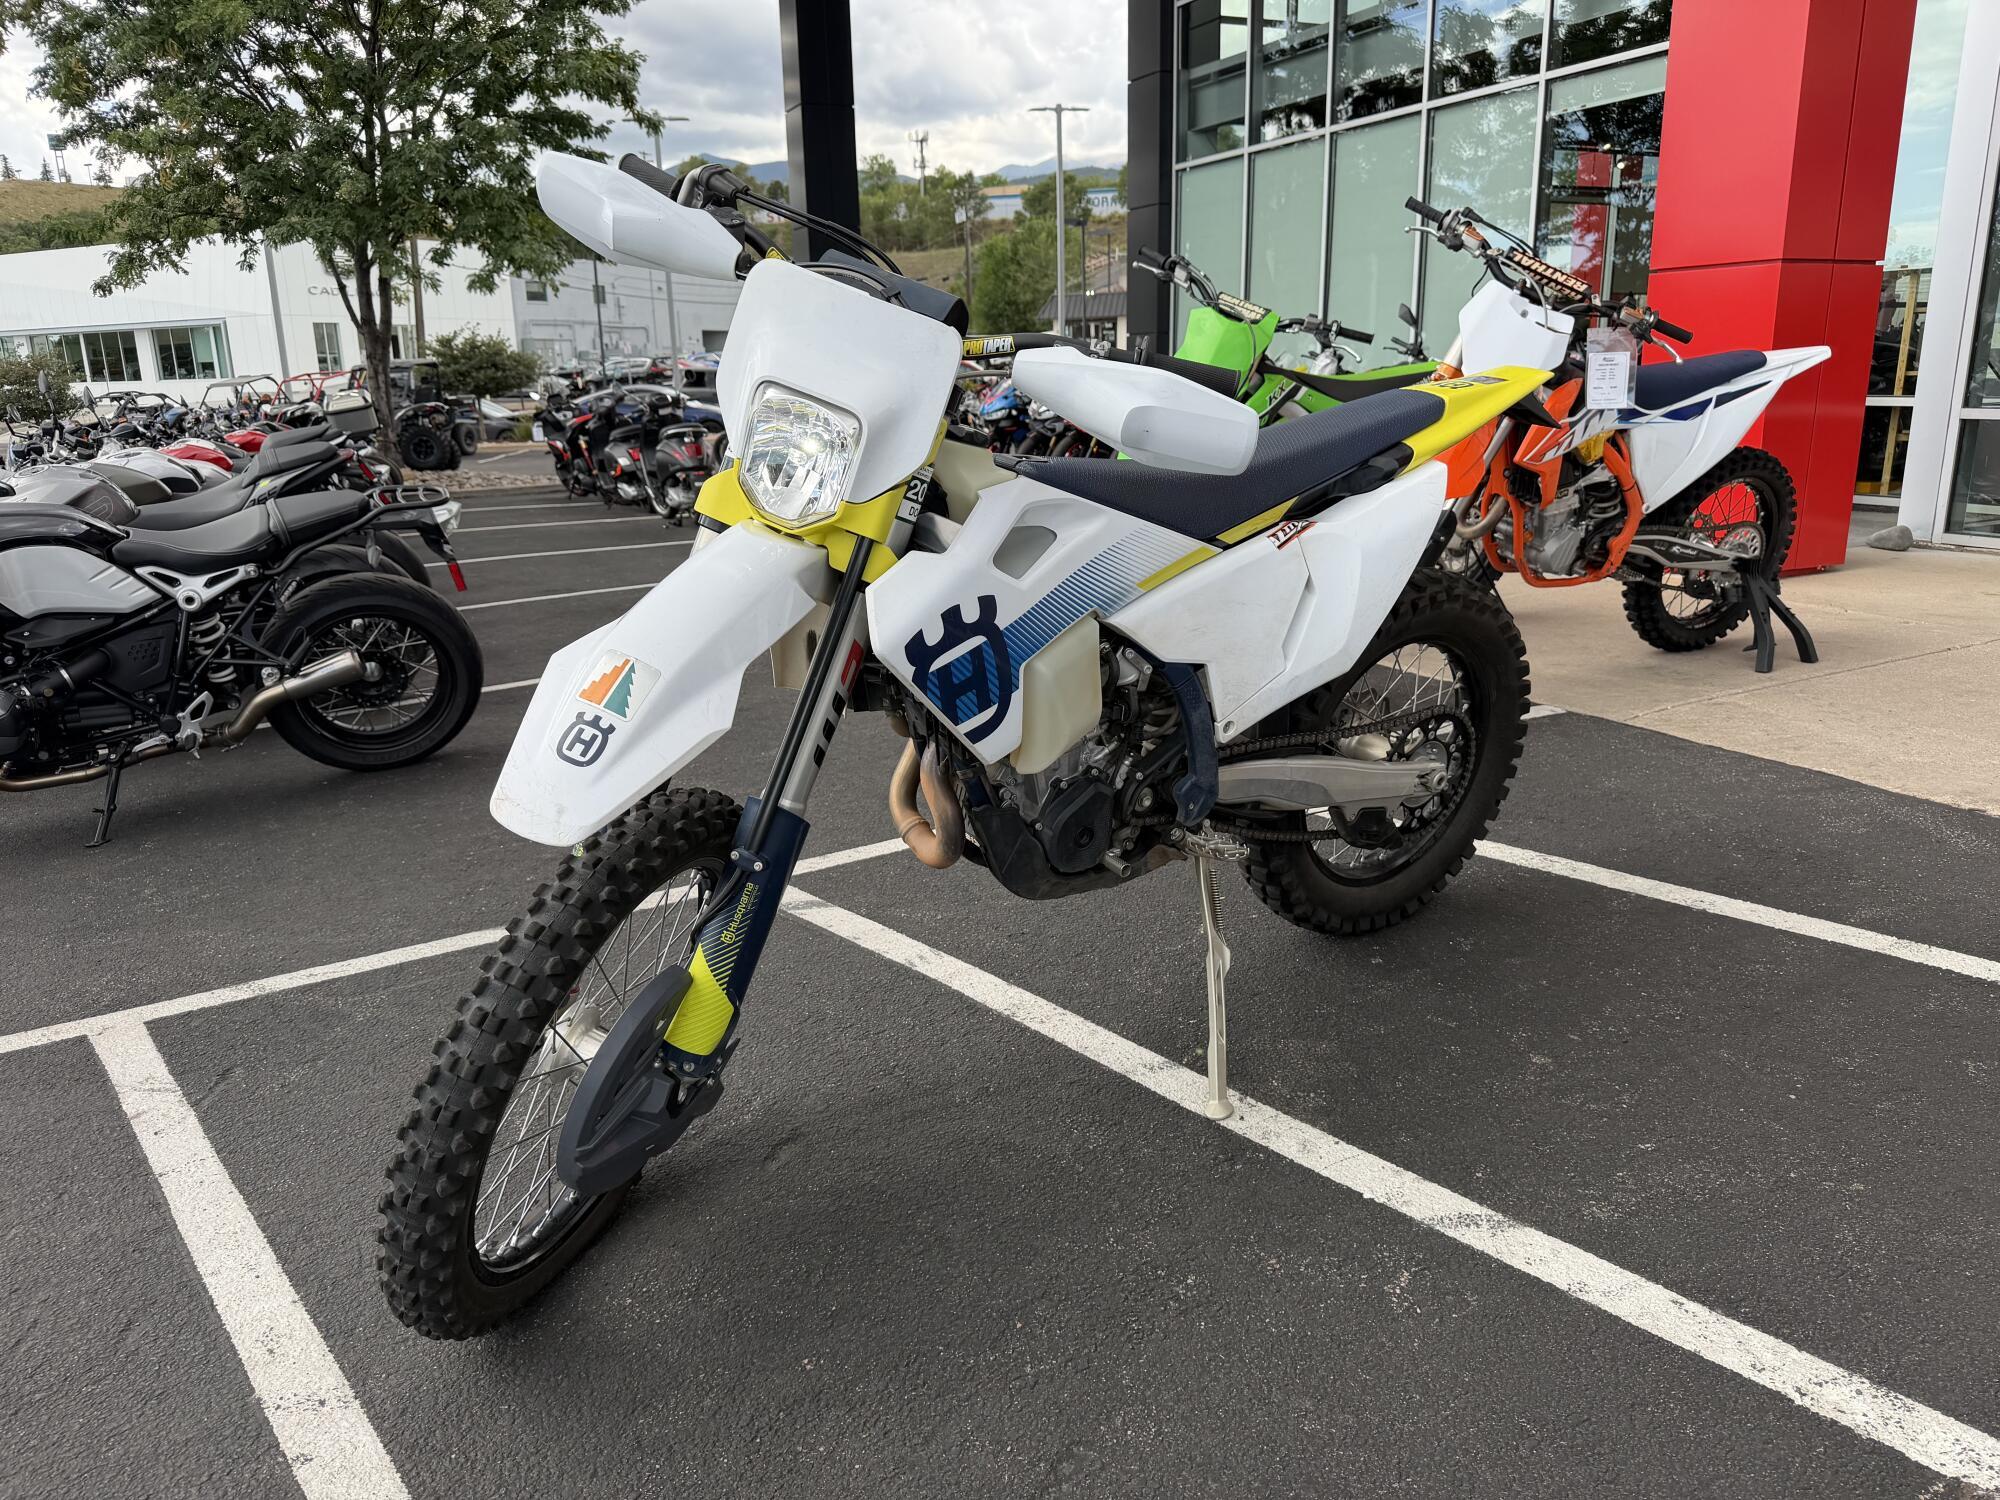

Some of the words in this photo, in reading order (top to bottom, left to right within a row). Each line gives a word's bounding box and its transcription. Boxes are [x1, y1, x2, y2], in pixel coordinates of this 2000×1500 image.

[1512, 250, 1589, 292] RENTHAL
[963, 338, 1011, 355] PROTAPER
[727, 882, 753, 932] Husqvarna
